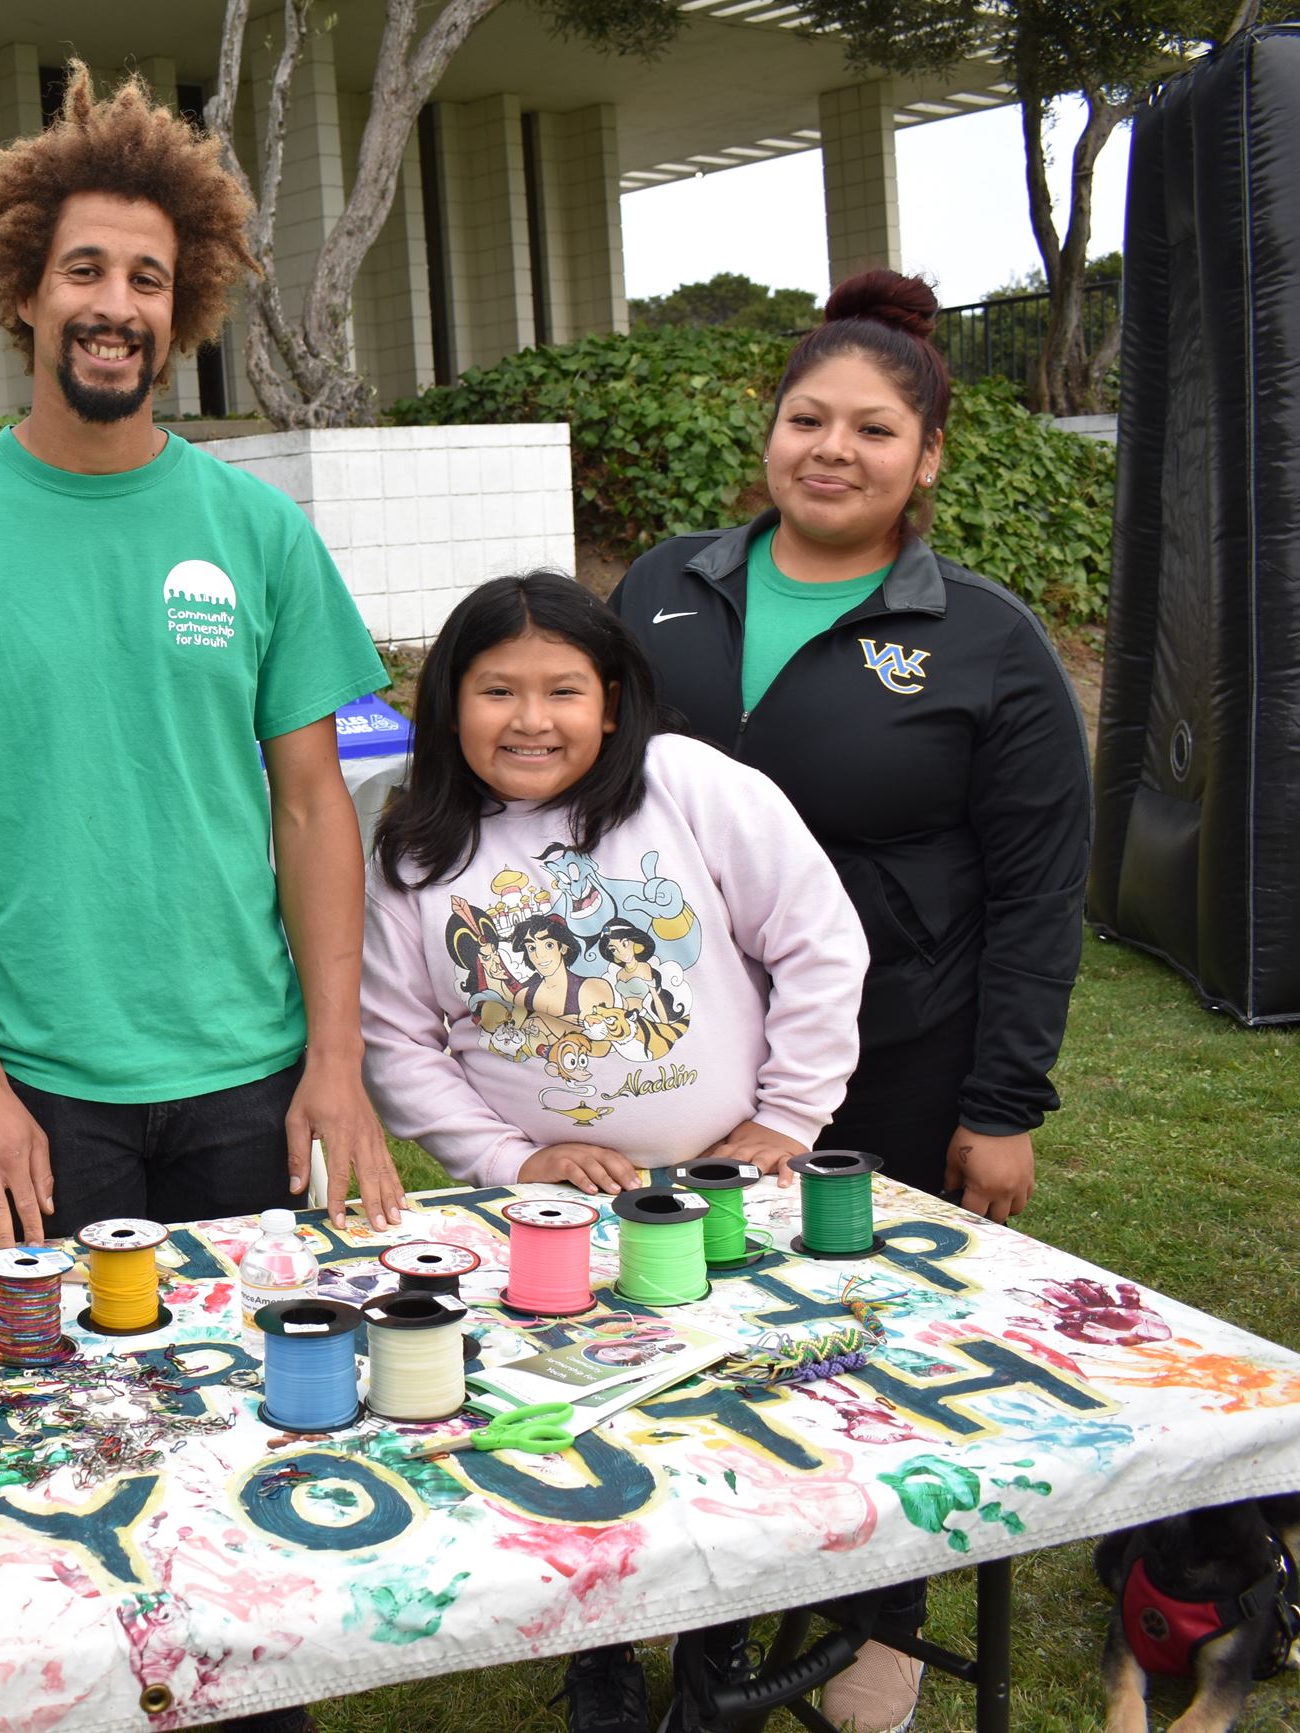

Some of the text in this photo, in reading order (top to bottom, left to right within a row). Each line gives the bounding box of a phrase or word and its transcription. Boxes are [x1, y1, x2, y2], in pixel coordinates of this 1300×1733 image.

[167, 607, 234, 625] Community
[167, 620, 235, 638] Partnership
[175, 633, 228, 648] for Youth
[601, 1063, 698, 1101] Aladdin
